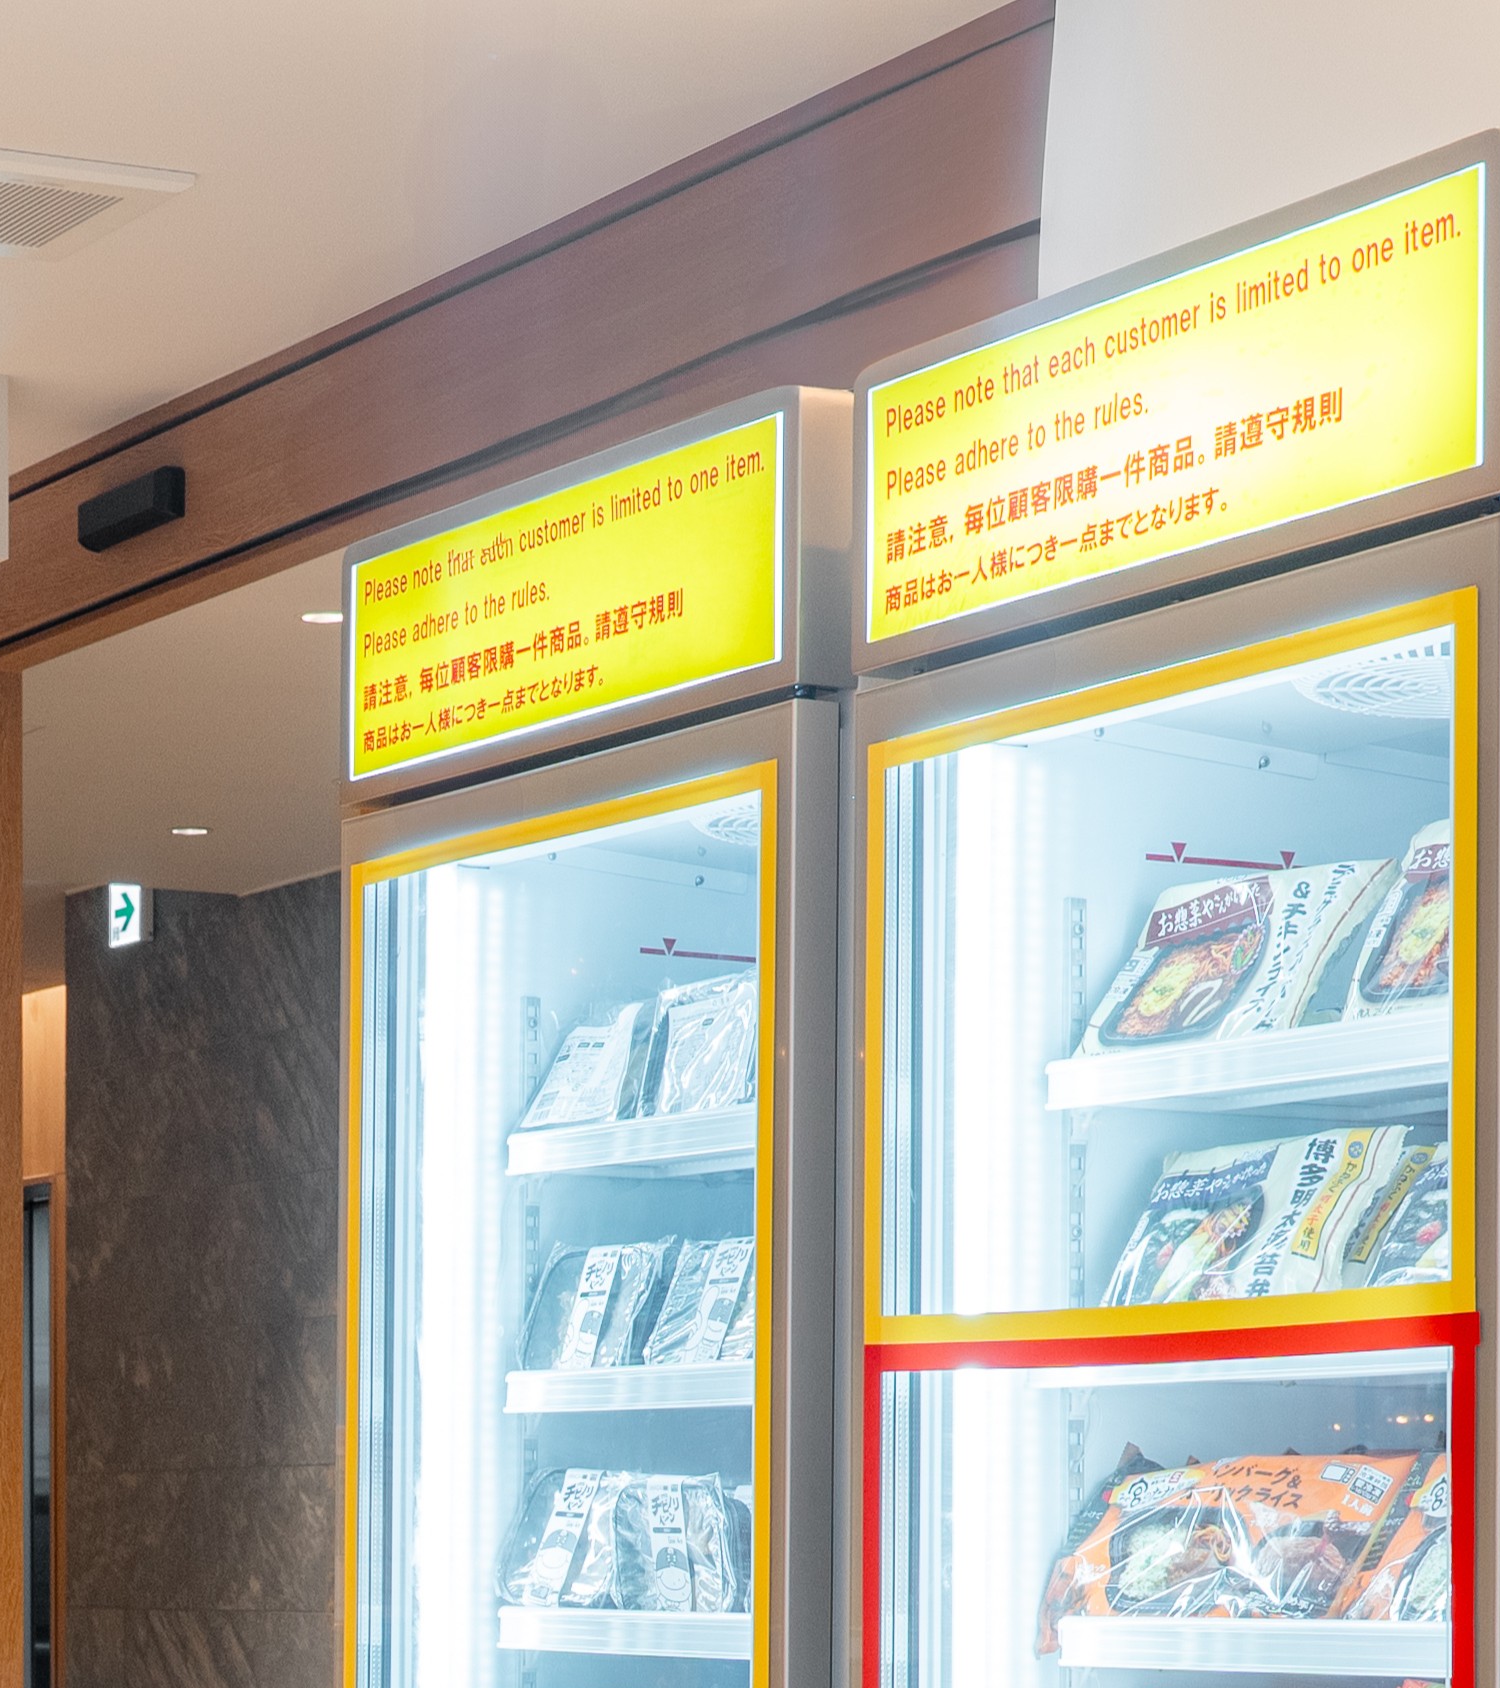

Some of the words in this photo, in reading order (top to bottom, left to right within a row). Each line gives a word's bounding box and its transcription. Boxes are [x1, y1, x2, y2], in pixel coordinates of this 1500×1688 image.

[886, 395, 946, 438] Please
[954, 375, 995, 413] note
[1003, 355, 1040, 394] that
[1049, 336, 1095, 378] each
[1104, 303, 1201, 358] customer
[1210, 292, 1226, 323] is
[1236, 259, 1309, 314] limited
[1319, 253, 1341, 285] to
[1351, 237, 1394, 273] one
[1404, 212, 1462, 255] item.
[886, 461, 946, 499] Please
[955, 434, 1018, 476] adhere
[1028, 421, 1046, 451] to
[1055, 410, 1085, 442] the
[1094, 392, 1149, 430] rules.
[364, 571, 408, 606] Please
[412, 559, 443, 590] note
[519, 513, 586, 552] customer
[592, 501, 605, 529] is
[610, 480, 661, 521] limited
[667, 476, 683, 503] to
[690, 464, 719, 495] one
[725, 449, 766, 483] item.
[363, 624, 407, 658] Please
[412, 610, 459, 644] adhere
[464, 602, 478, 627] to
[484, 594, 506, 620] the
[511, 580, 551, 609] rules.
